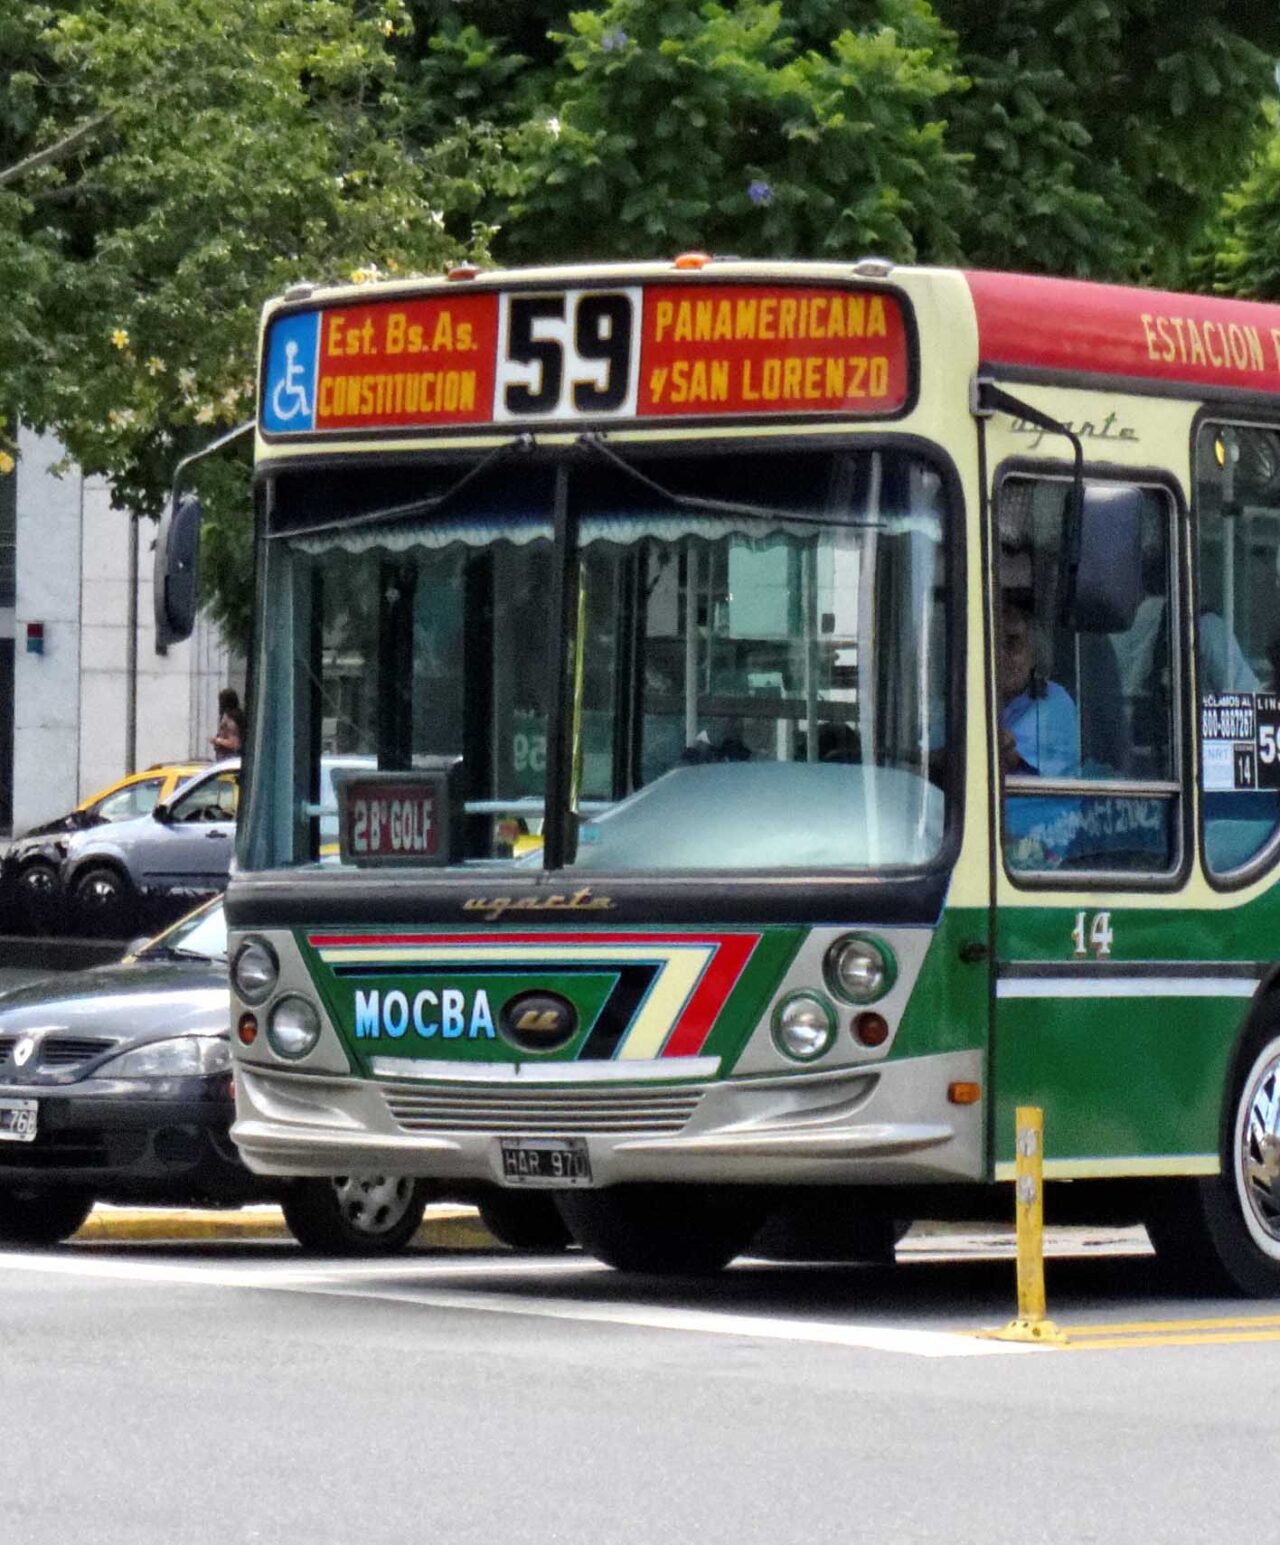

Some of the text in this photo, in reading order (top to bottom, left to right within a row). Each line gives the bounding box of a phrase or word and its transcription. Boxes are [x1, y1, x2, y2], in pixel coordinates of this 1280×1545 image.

[327, 316, 378, 357] Est.
[655, 295, 887, 342] PANAMERICANA
[504, 293, 631, 414] 59
[1141, 313, 1265, 372] ESTACION
[318, 370, 477, 417] CONSTITUCION
[742, 356, 889, 401] LORENZO
[1238, 756, 1251, 784] 14
[391, 799, 432, 850] GOLF
[1072, 911, 1113, 960] 14
[354, 988, 496, 1040] MOCBA
[504, 1150, 540, 1175] HAR
